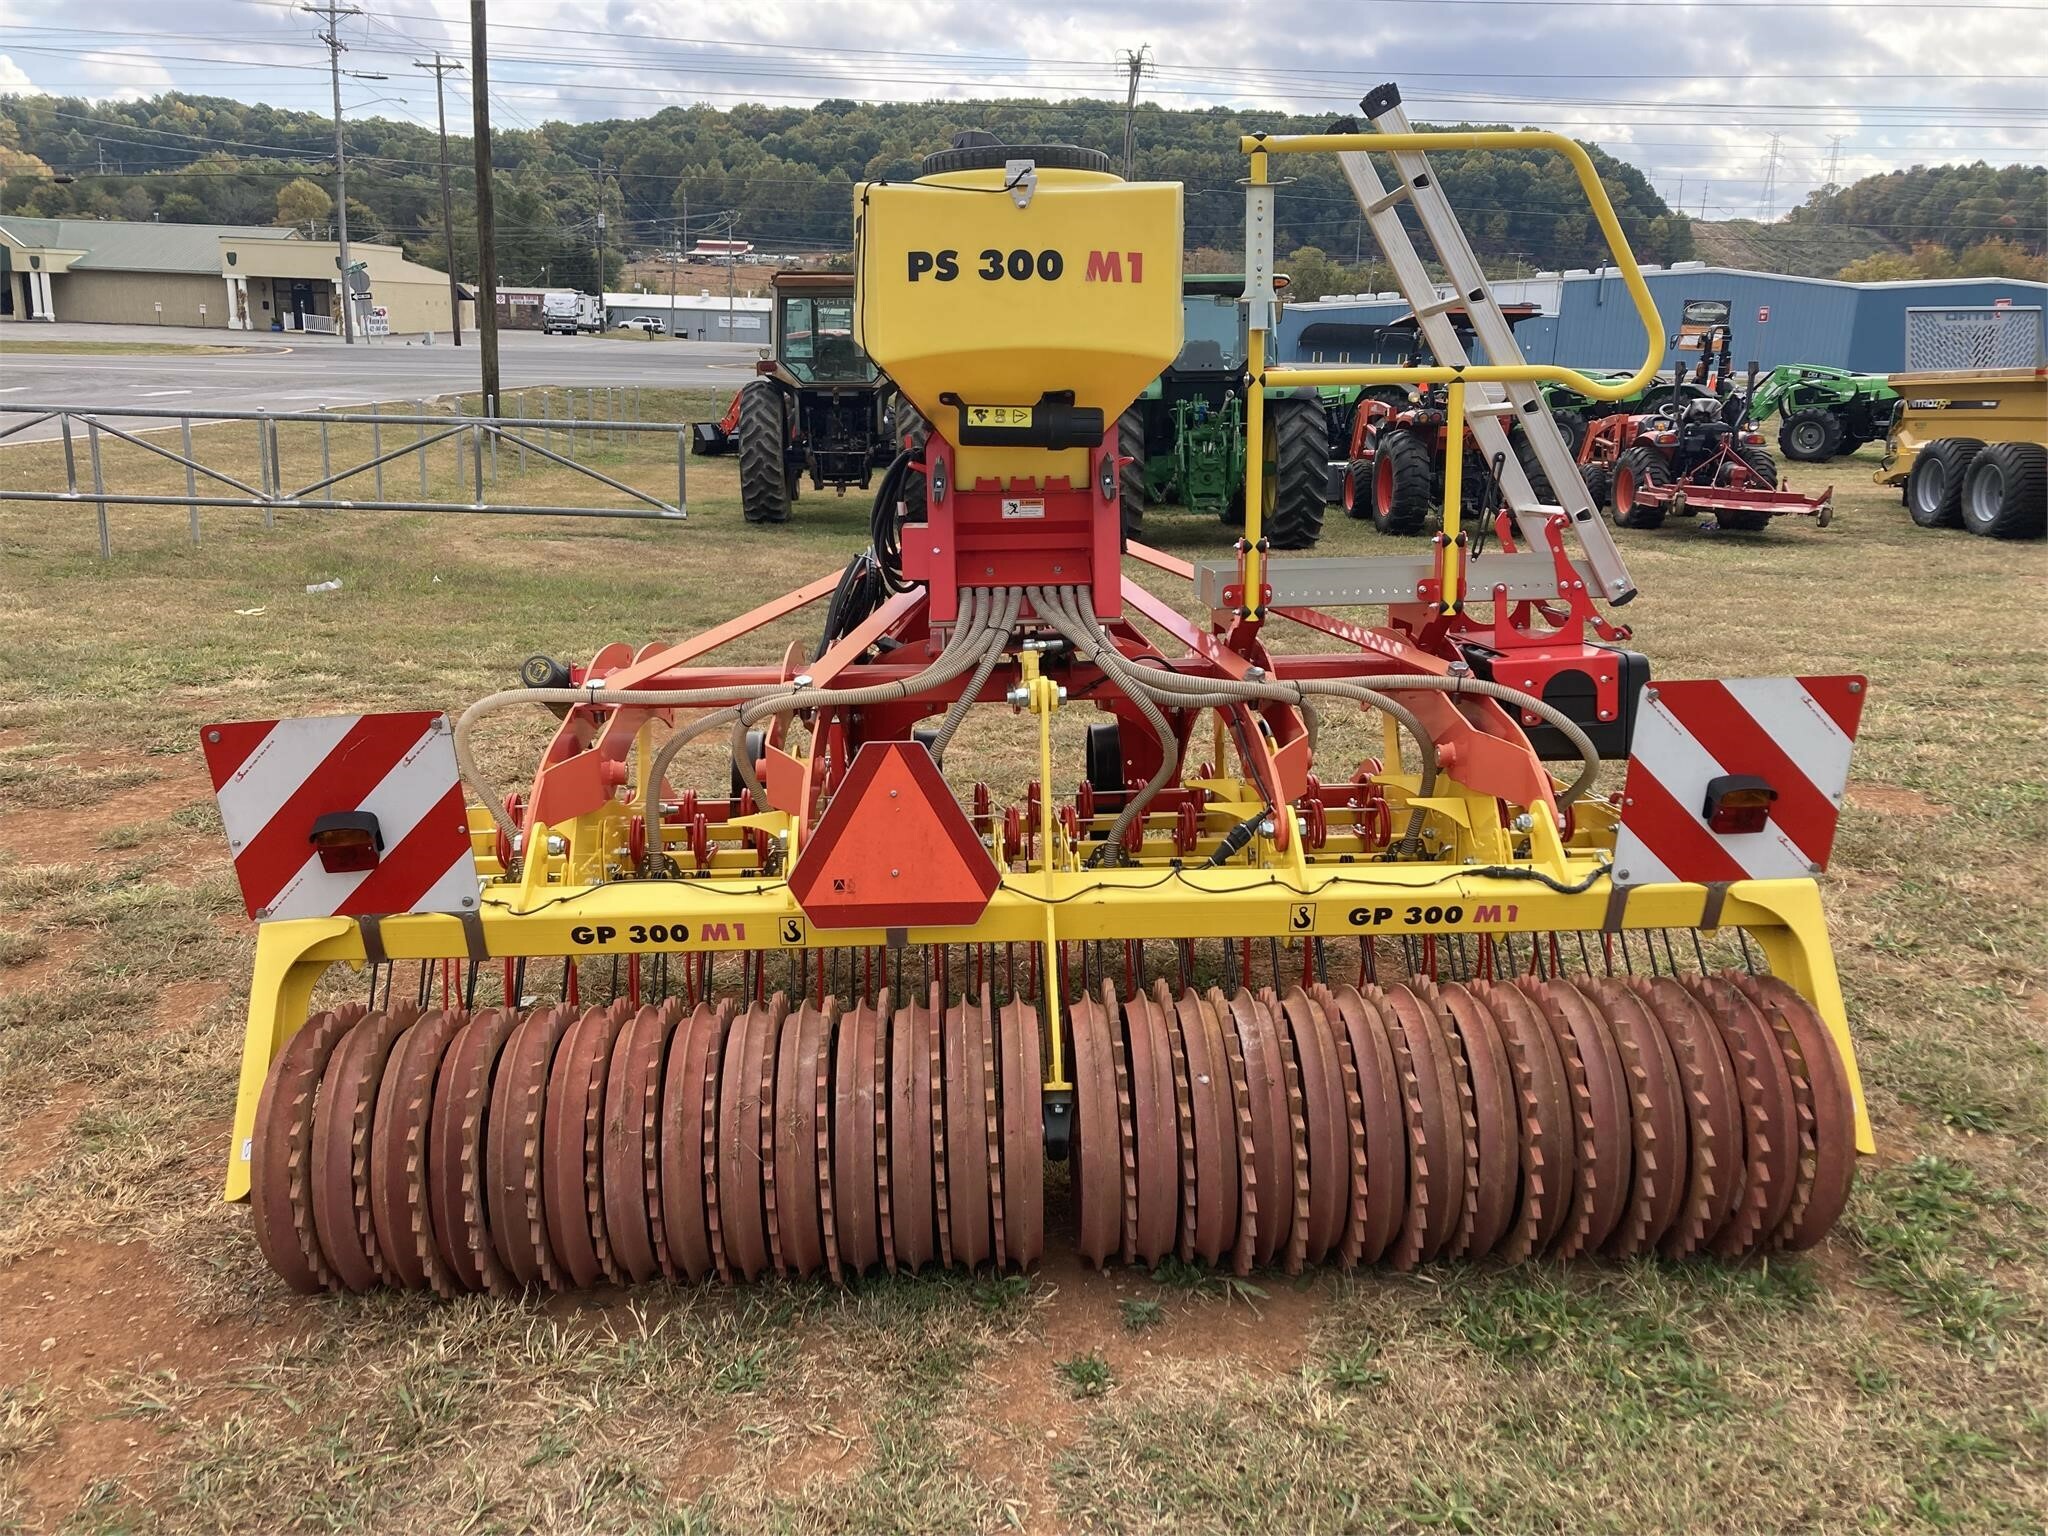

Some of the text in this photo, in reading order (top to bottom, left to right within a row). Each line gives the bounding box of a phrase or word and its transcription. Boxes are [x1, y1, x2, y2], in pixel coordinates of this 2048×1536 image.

[907, 249, 1142, 282] PS 300 M1
[1348, 905, 1519, 926] GP 300 M1
[570, 923, 746, 945] GP 300 M1
